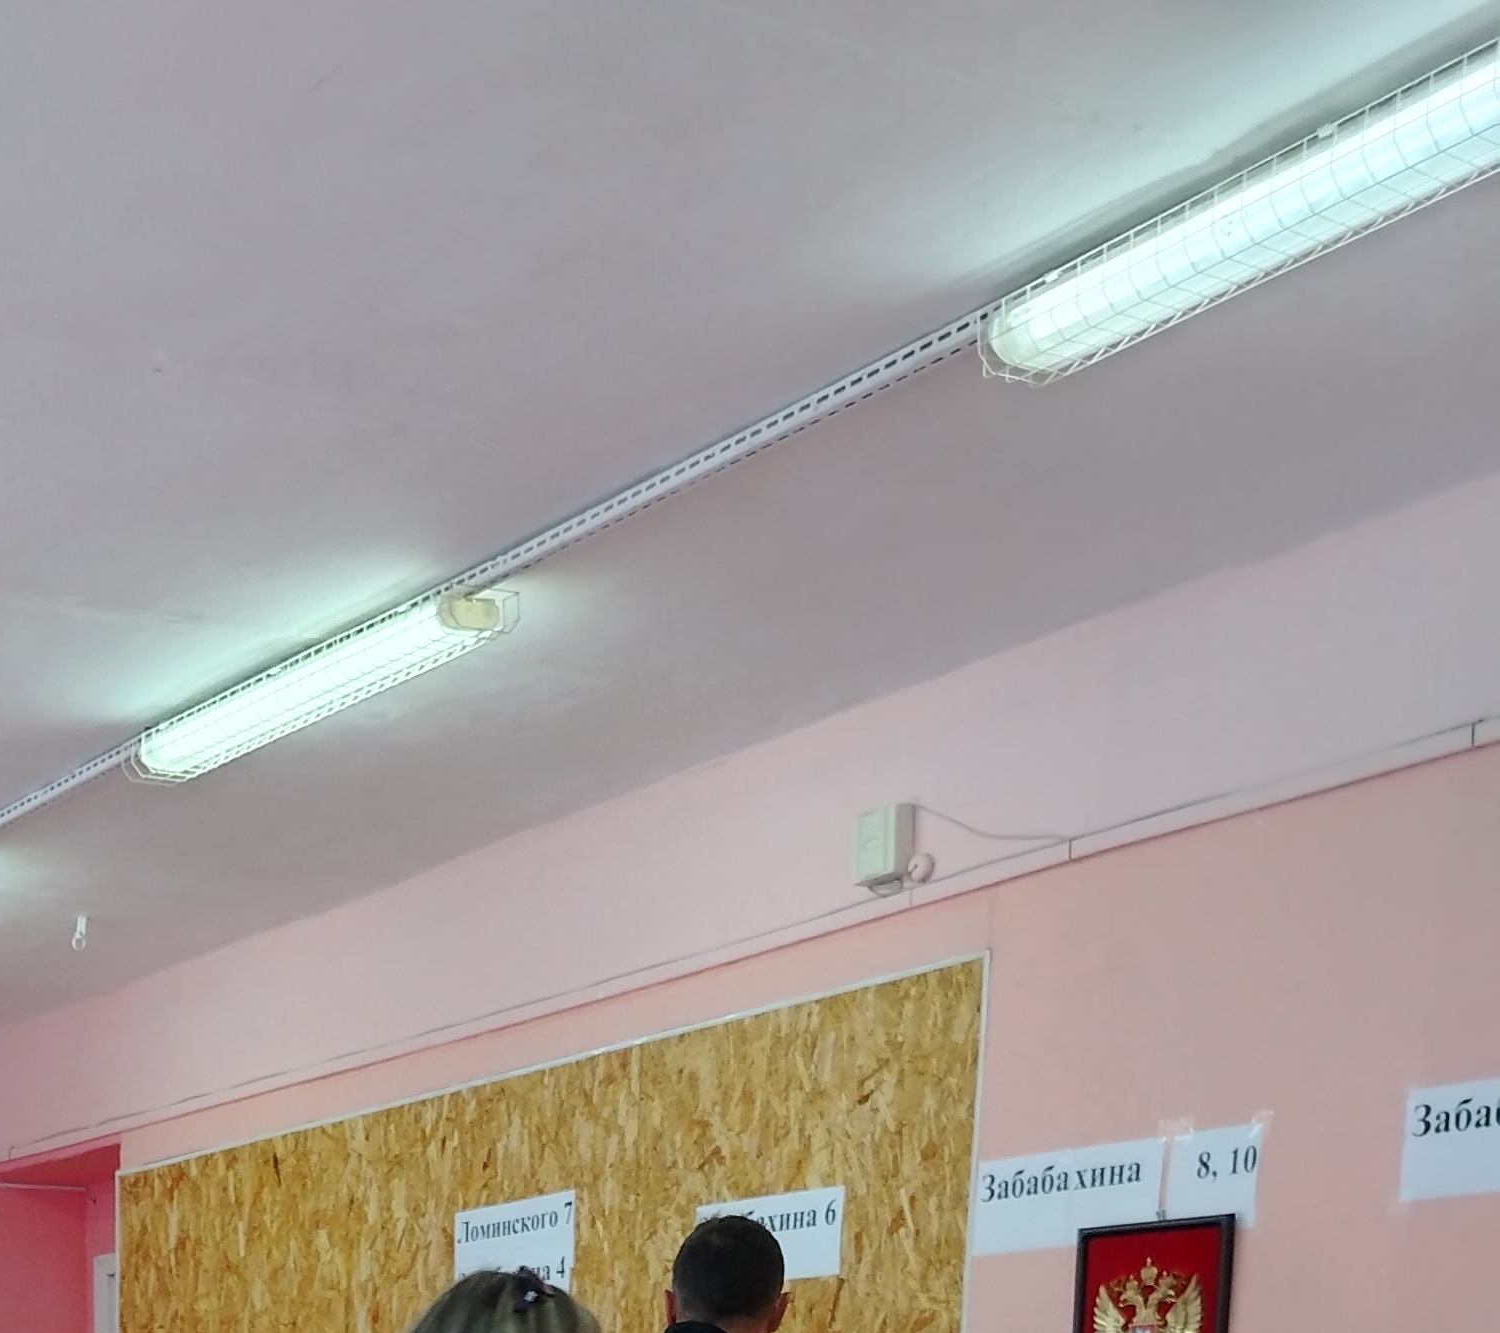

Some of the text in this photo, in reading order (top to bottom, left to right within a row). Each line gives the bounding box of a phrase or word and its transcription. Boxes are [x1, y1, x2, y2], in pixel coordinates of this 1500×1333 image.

[1412, 1097, 1500, 1137] Заба
[980, 1145, 1257, 1202] Забабахина 8, 10
[457, 1201, 573, 1244] Ломинского 7
[825, 1199, 838, 1226] 6
[556, 1256, 565, 1279] 4
